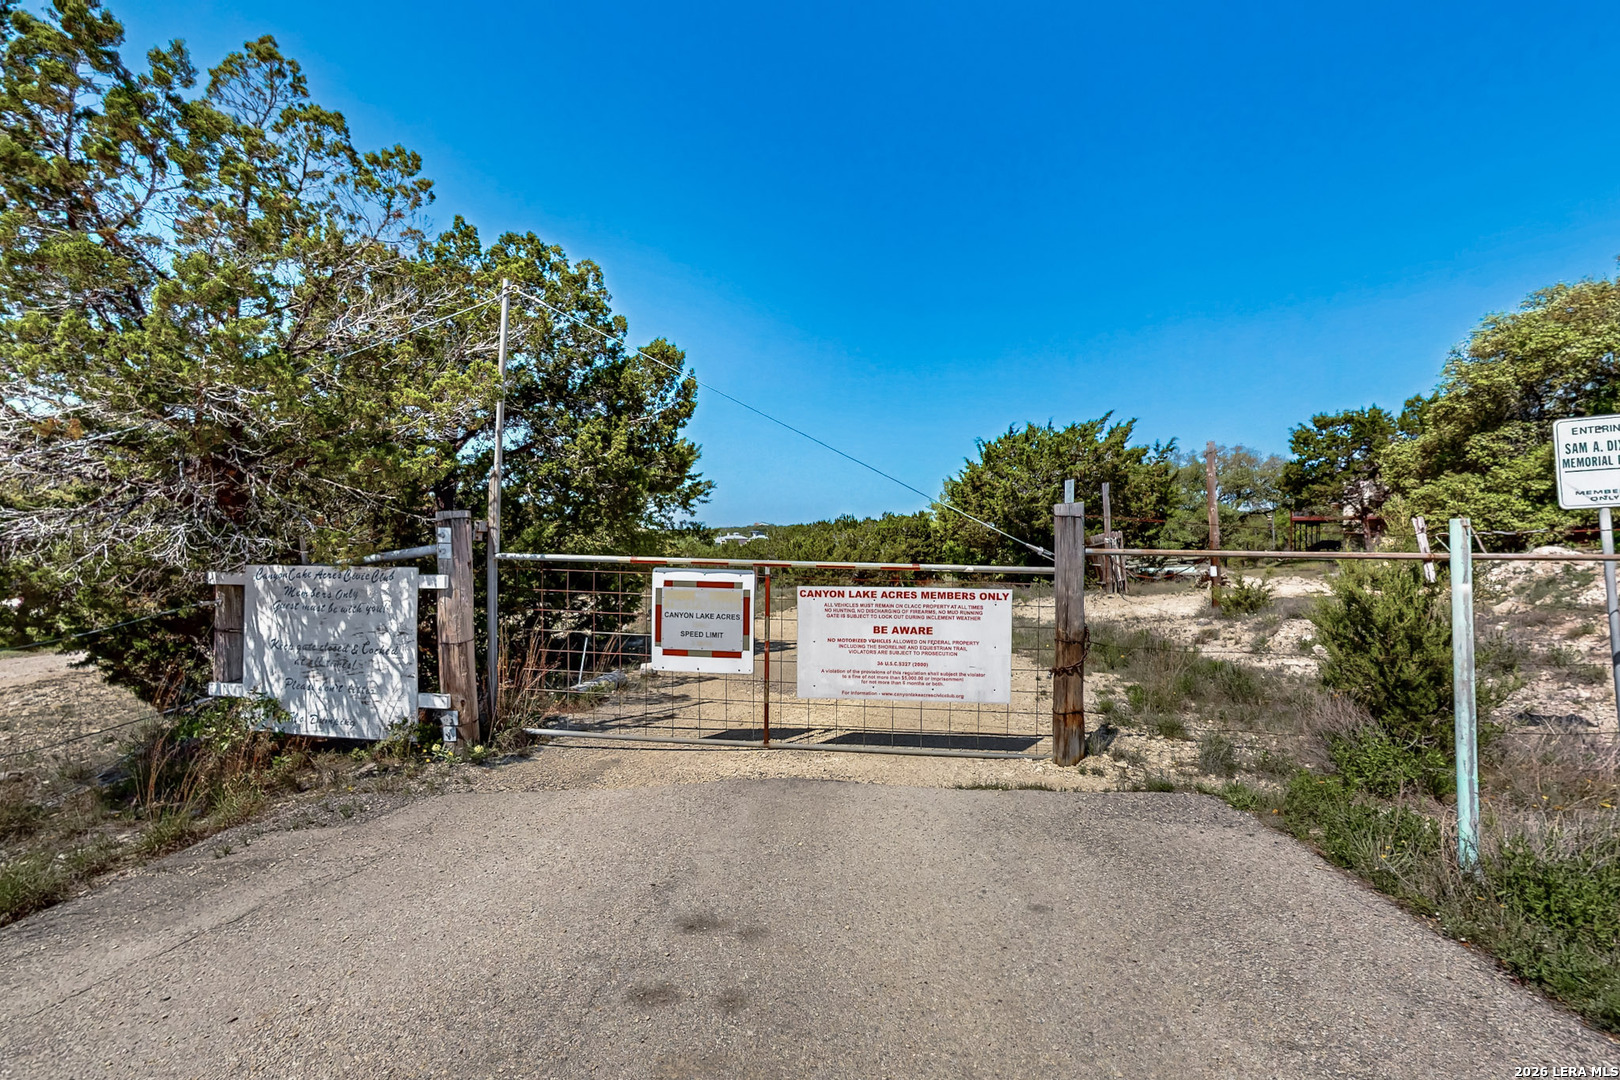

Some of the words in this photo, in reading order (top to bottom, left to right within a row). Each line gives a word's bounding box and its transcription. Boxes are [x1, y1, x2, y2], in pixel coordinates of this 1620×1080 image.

[1565, 442, 1588, 454] SAM
[1593, 441, 1603, 452] A.
[1562, 456, 1613, 468] MEMORIAL
[256, 567, 288, 582] Canyon
[314, 569, 342, 580] Acres
[344, 569, 370, 582] Civic
[372, 569, 396, 584] Club
[284, 586, 332, 598] Members
[336, 588, 358, 600] Only
[800, 590, 845, 598] CANYON
[848, 590, 878, 598] LAKE
[880, 591, 917, 599] ACRES
[920, 592, 976, 600] MEMBERS
[980, 592, 1010, 600] ONLY
[273, 600, 300, 614] Guest
[302, 604, 326, 612] must
[328, 602, 338, 613] be
[340, 602, 362, 614] with
[873, 626, 888, 634] BE
[891, 626, 933, 635] AWARE
